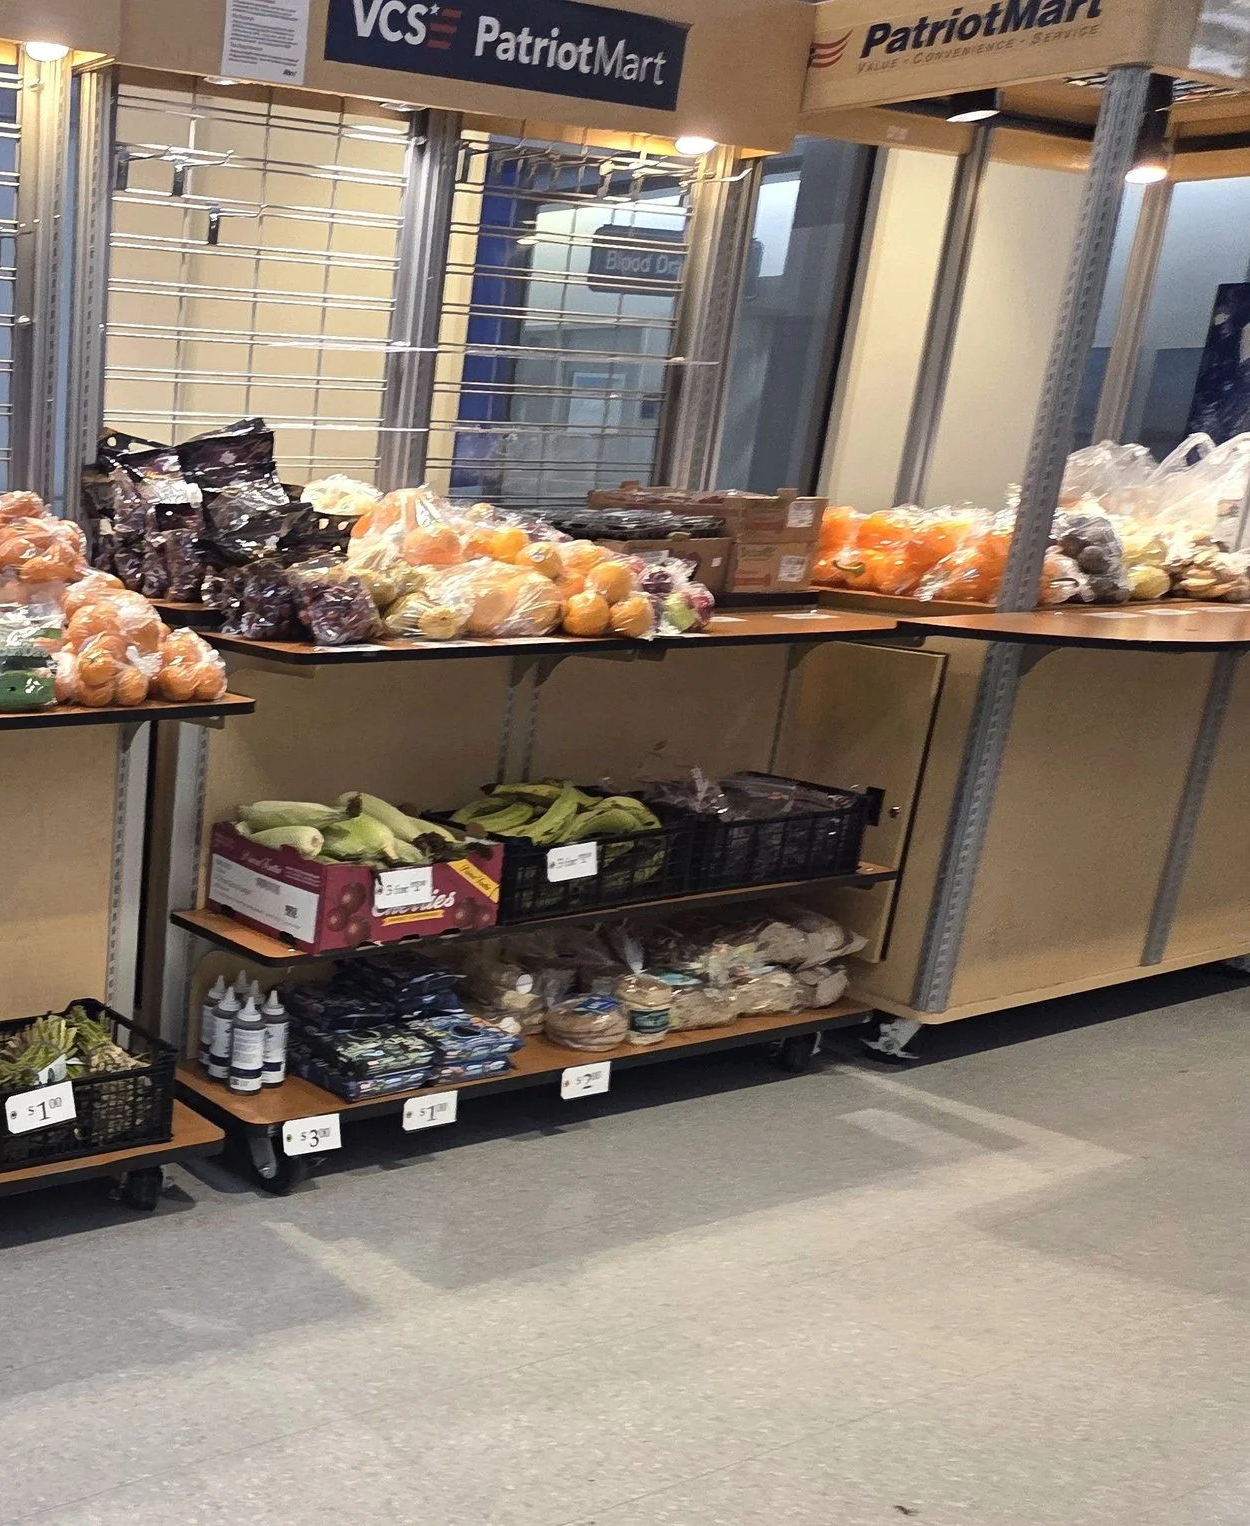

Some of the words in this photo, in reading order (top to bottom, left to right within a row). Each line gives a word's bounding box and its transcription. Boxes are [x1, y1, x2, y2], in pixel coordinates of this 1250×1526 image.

[352, 0, 430, 46] VCS
[473, 15, 668, 86] PatriotMart
[859, 0, 1103, 59] PatriotMart
[605, 249, 653, 273] Blood
